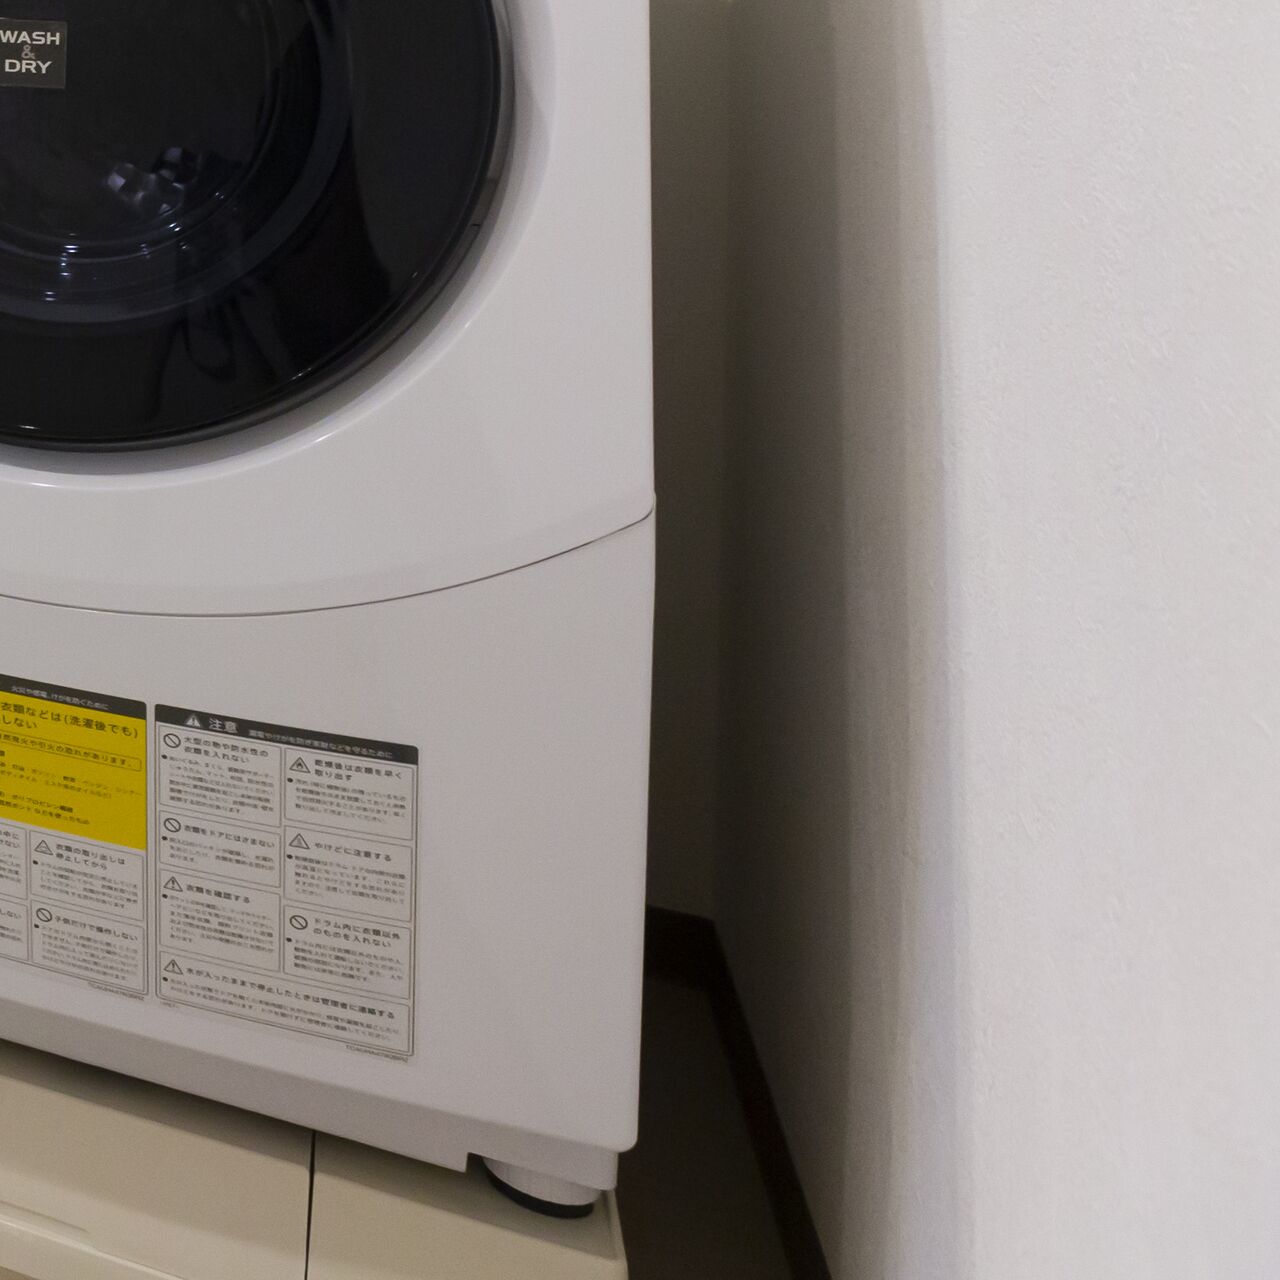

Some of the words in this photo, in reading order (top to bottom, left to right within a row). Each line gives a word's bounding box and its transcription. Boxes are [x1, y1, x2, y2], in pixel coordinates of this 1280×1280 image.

[0, 30, 60, 45] WASH
[21, 45, 35, 59] &
[5, 59, 52, 74] DRY
[208, 717, 238, 734] 注意
[184, 736, 269, 758] 大型の物や防水性の
[184, 746, 250, 764] 衣類を入れない
[314, 758, 403, 780] 乾燥後は衣類を早く
[314, 768, 353, 782] 取り出す
[184, 824, 275, 849] 衣類をドアにはさまない
[56, 843, 125, 865] 衣類の取り出しは
[314, 841, 392, 862] やけどに注意する
[186, 884, 250, 904] 衣類を確認する
[313, 927, 392, 948] のものを入れない
[314, 917, 401, 941] ドラム内に衣類以外
